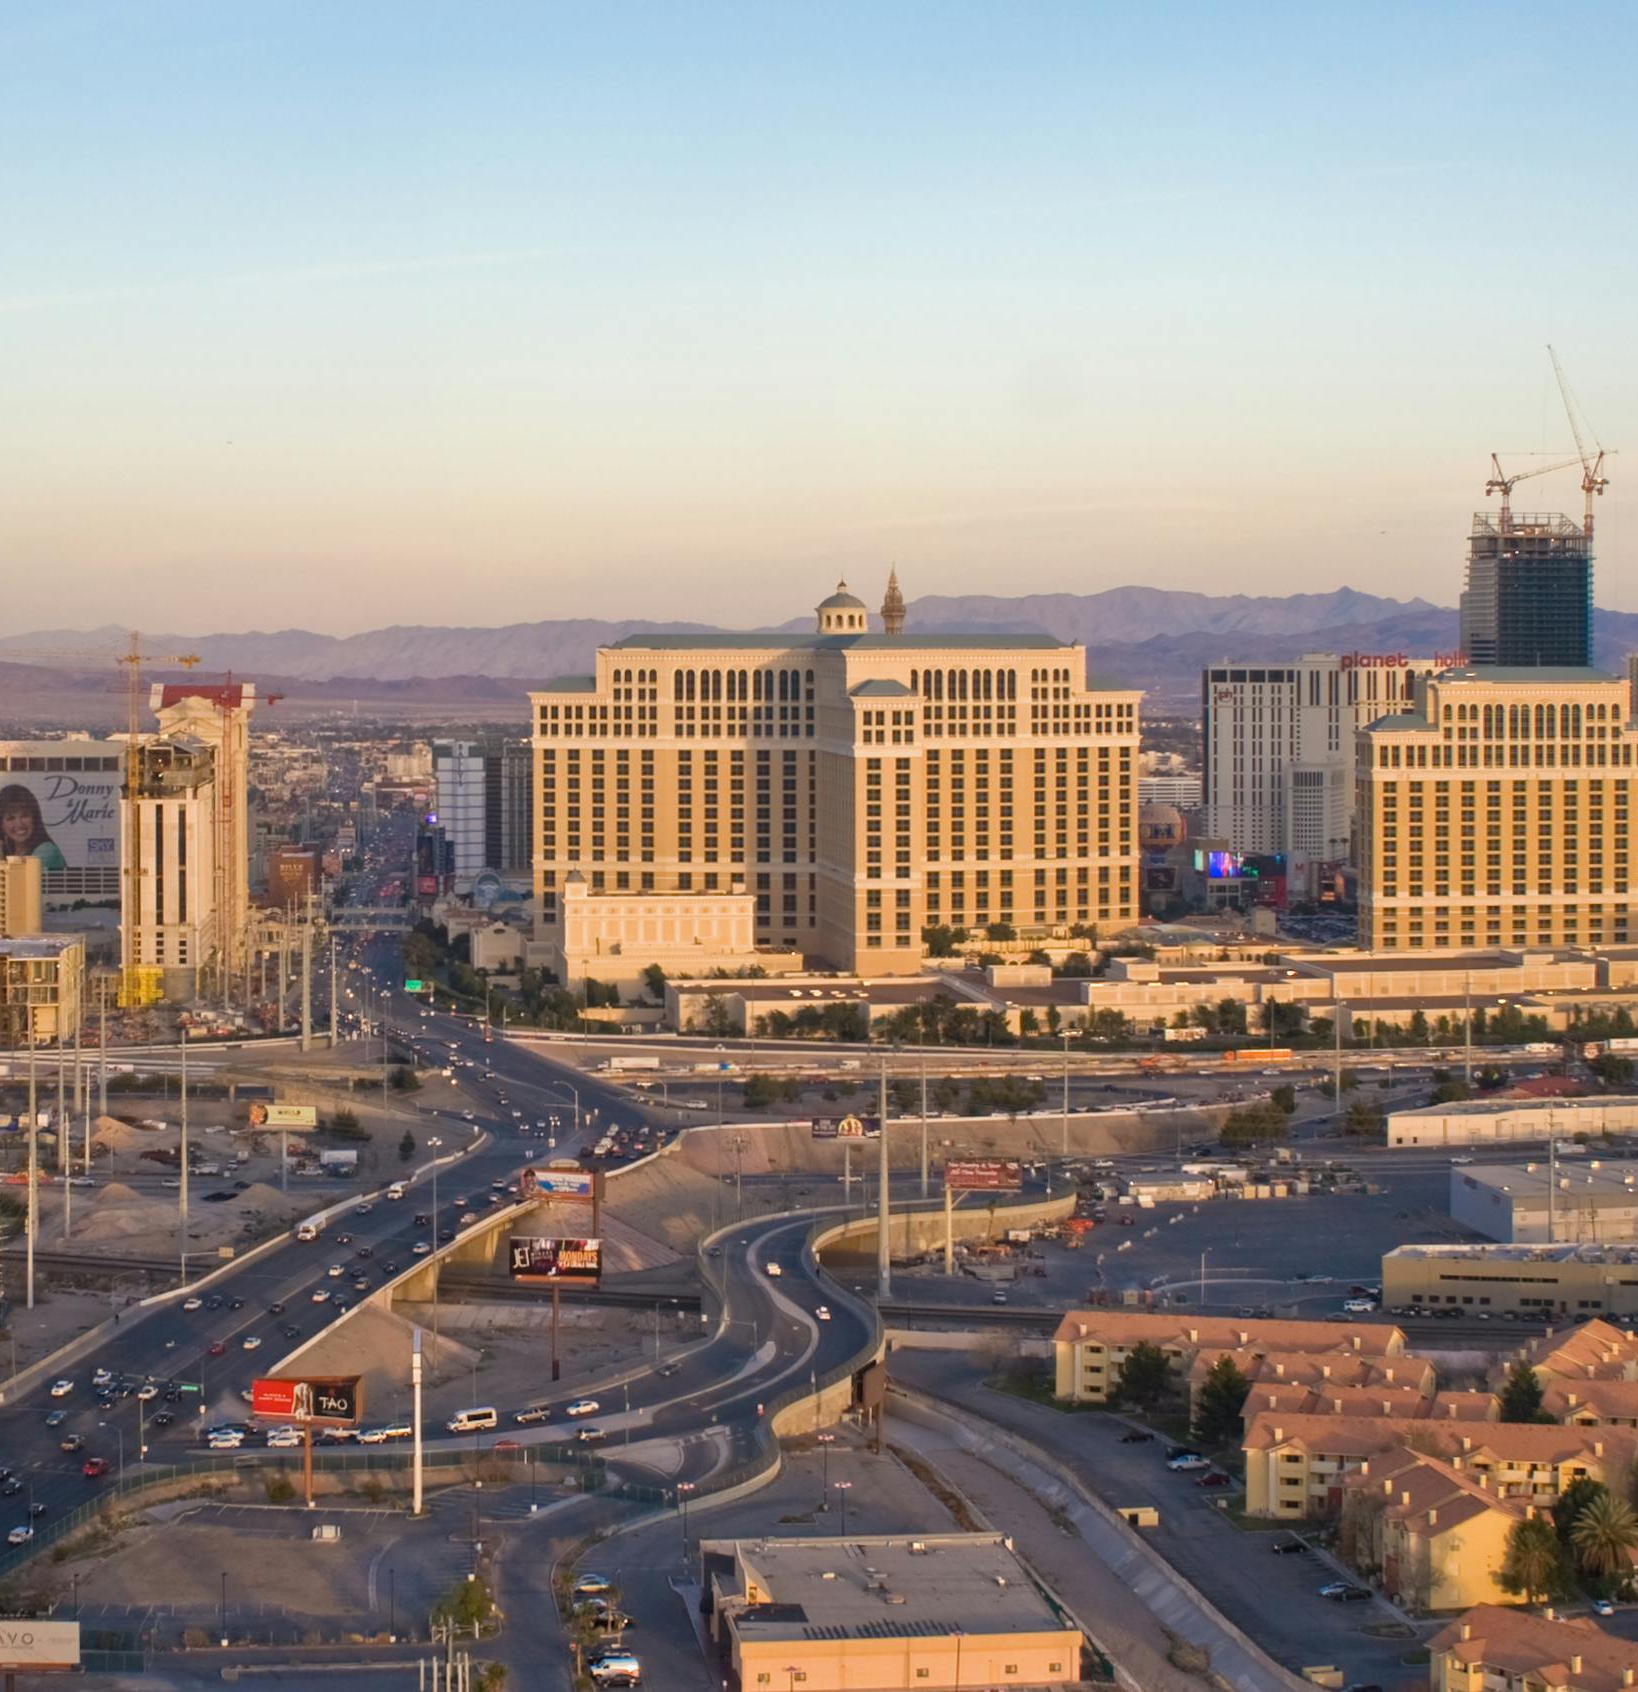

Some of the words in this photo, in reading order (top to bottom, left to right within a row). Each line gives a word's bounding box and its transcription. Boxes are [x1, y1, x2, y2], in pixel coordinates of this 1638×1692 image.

[1341, 651, 1410, 672] planet
[43, 775, 115, 801] Donny
[44, 798, 116, 827] Marie
[89, 840, 113, 850] SKY
[513, 1246, 531, 1269] JET
[558, 1250, 598, 1262] MONDAYS
[318, 1396, 348, 1412] TAO
